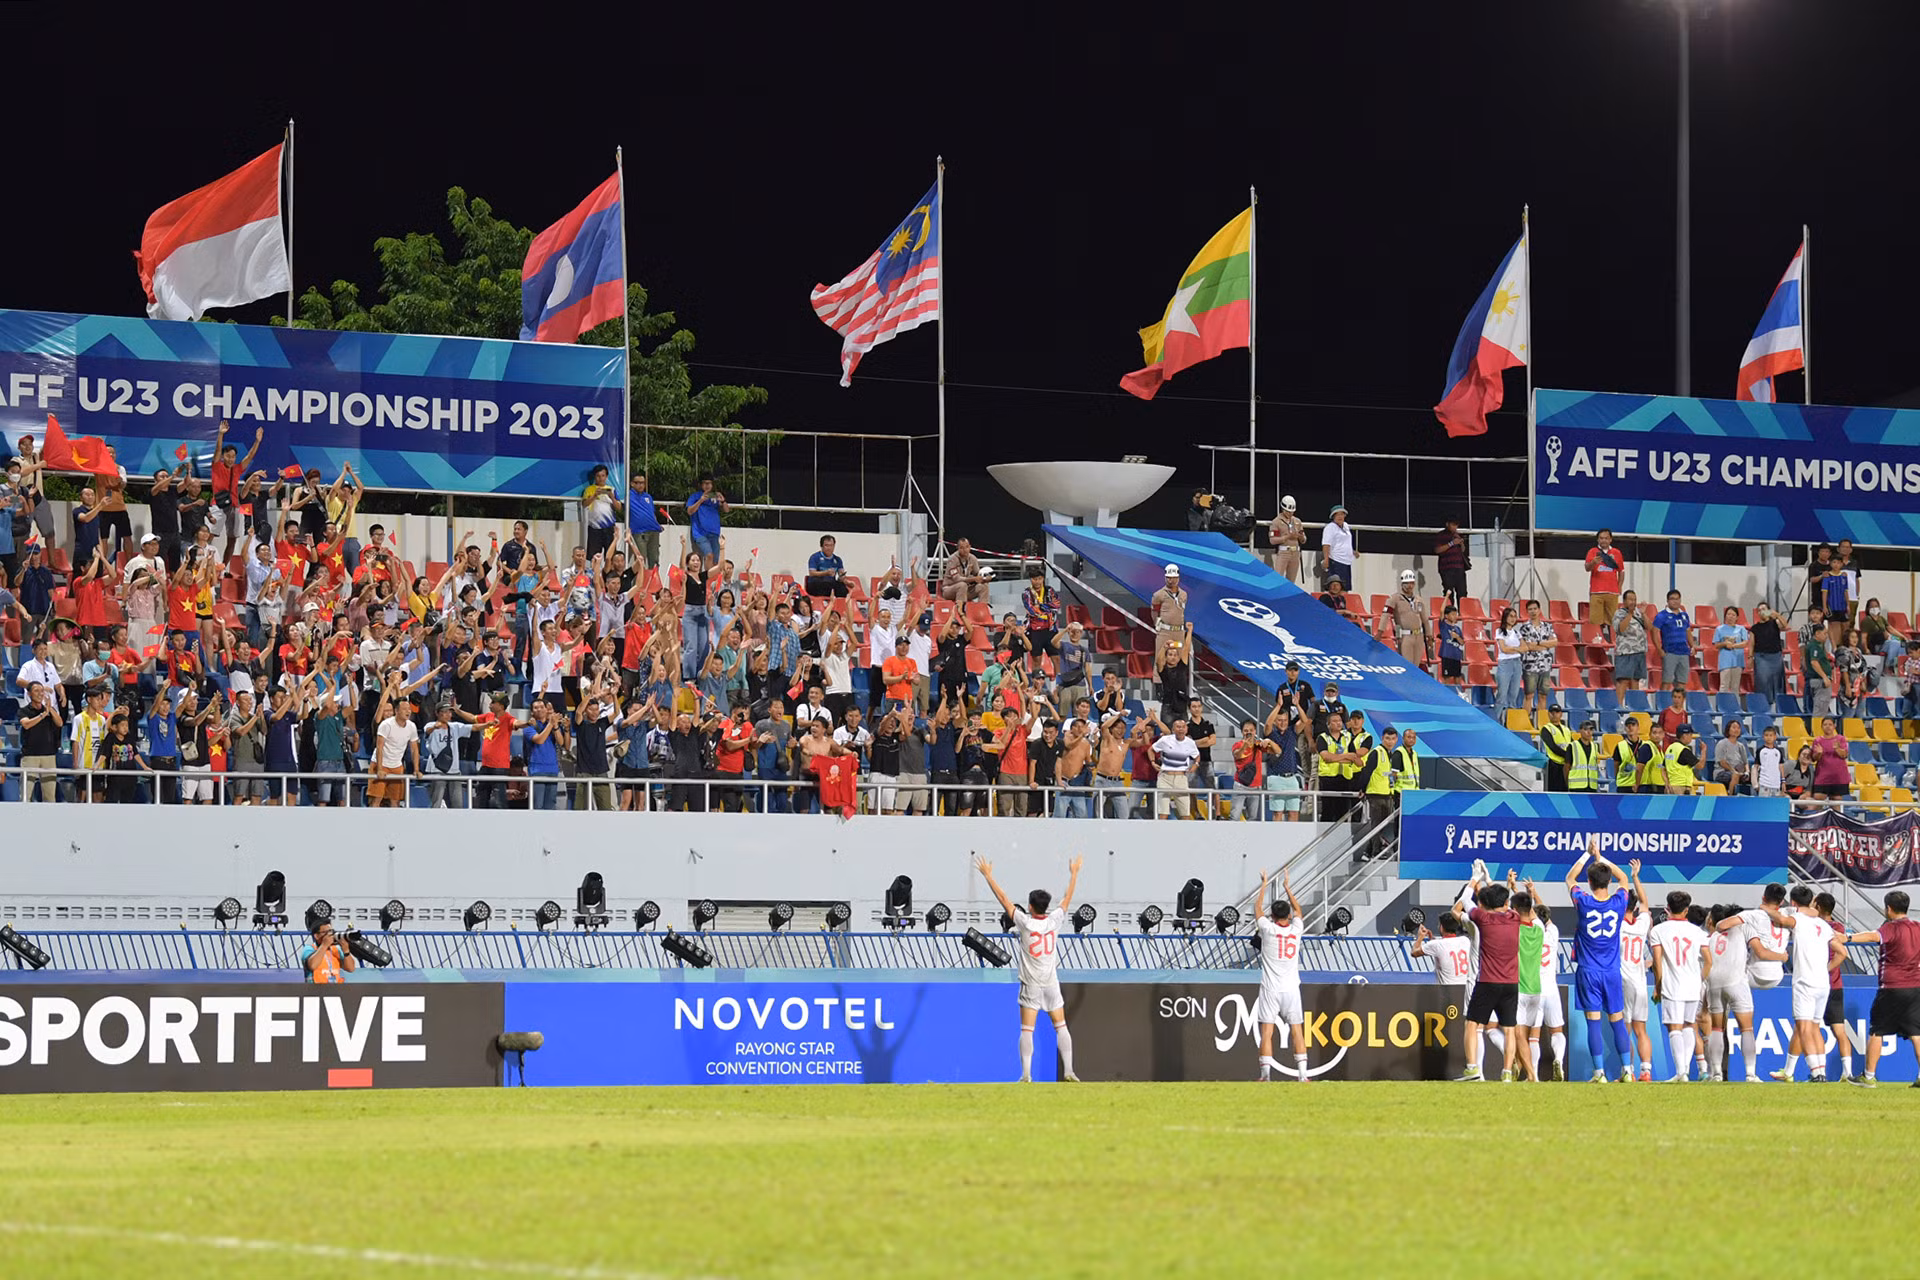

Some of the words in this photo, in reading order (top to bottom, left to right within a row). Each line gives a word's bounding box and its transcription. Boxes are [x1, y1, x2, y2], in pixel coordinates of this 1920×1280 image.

[0, 372, 65, 408] FF
[78, 376, 160, 415] U23
[172, 382, 500, 433] CHAMPIONSHIP
[509, 402, 604, 440] 2023
[1568, 446, 1639, 479] AFF
[1649, 450, 1711, 484] U23
[1720, 454, 1920, 494] CHAMPIONS
[1313, 655, 1360, 665] U23
[1306, 669, 1364, 681] 2023
[1458, 829, 1498, 849] AFF
[1502, 830, 1539, 851] U23
[1543, 831, 1692, 853] CHAMPIONSHIP
[1695, 833, 1743, 854] 2023
[1586, 909, 1619, 939] 23
[1029, 930, 1055, 959] 20
[1275, 933, 1297, 960] 16
[1622, 935, 1643, 965] 10
[1673, 935, 1693, 967] 17
[1714, 934, 1727, 956] 6
[1449, 948, 1469, 977] 18
[674, 996, 895, 1031] NOVOTEL
[735, 1041, 796, 1056] RAYONG
[799, 1041, 835, 1056] STAR
[705, 1060, 803, 1076] CONVENTION
[805, 1060, 862, 1075] CENTRE
